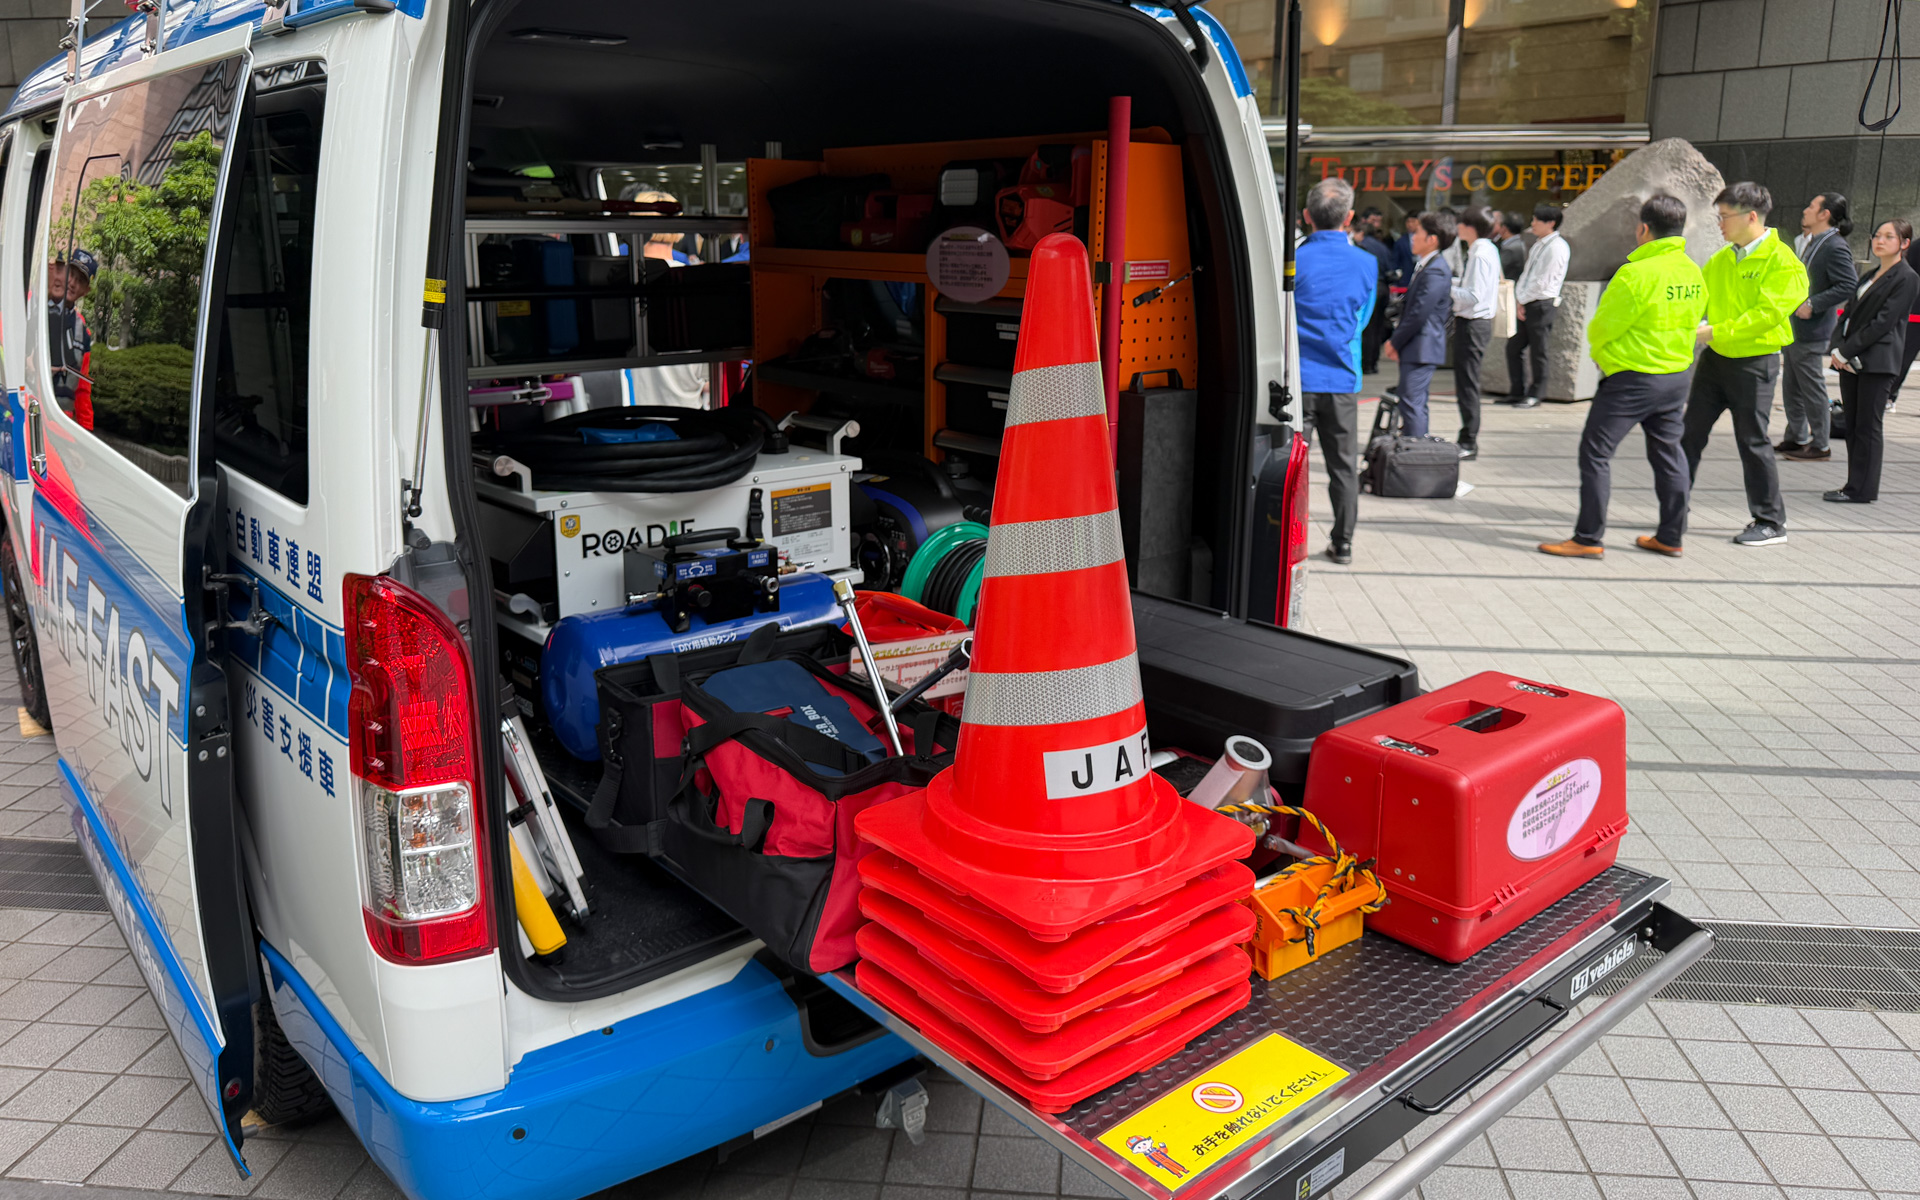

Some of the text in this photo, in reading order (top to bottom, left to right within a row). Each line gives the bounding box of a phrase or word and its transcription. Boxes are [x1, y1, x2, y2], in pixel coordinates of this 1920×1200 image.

[1462, 163, 1607, 191] COFFEE
[1666, 284, 1701, 300] STAFF
[34, 520, 181, 820] JAF-FAST
[245, 680, 335, 798] 災害支援車
[800, 704, 820, 721] BOX
[1071, 732, 1148, 790] JAF
[127, 900, 169, 1011] Team
[1192, 1070, 1328, 1156] お手を触れないでください。
